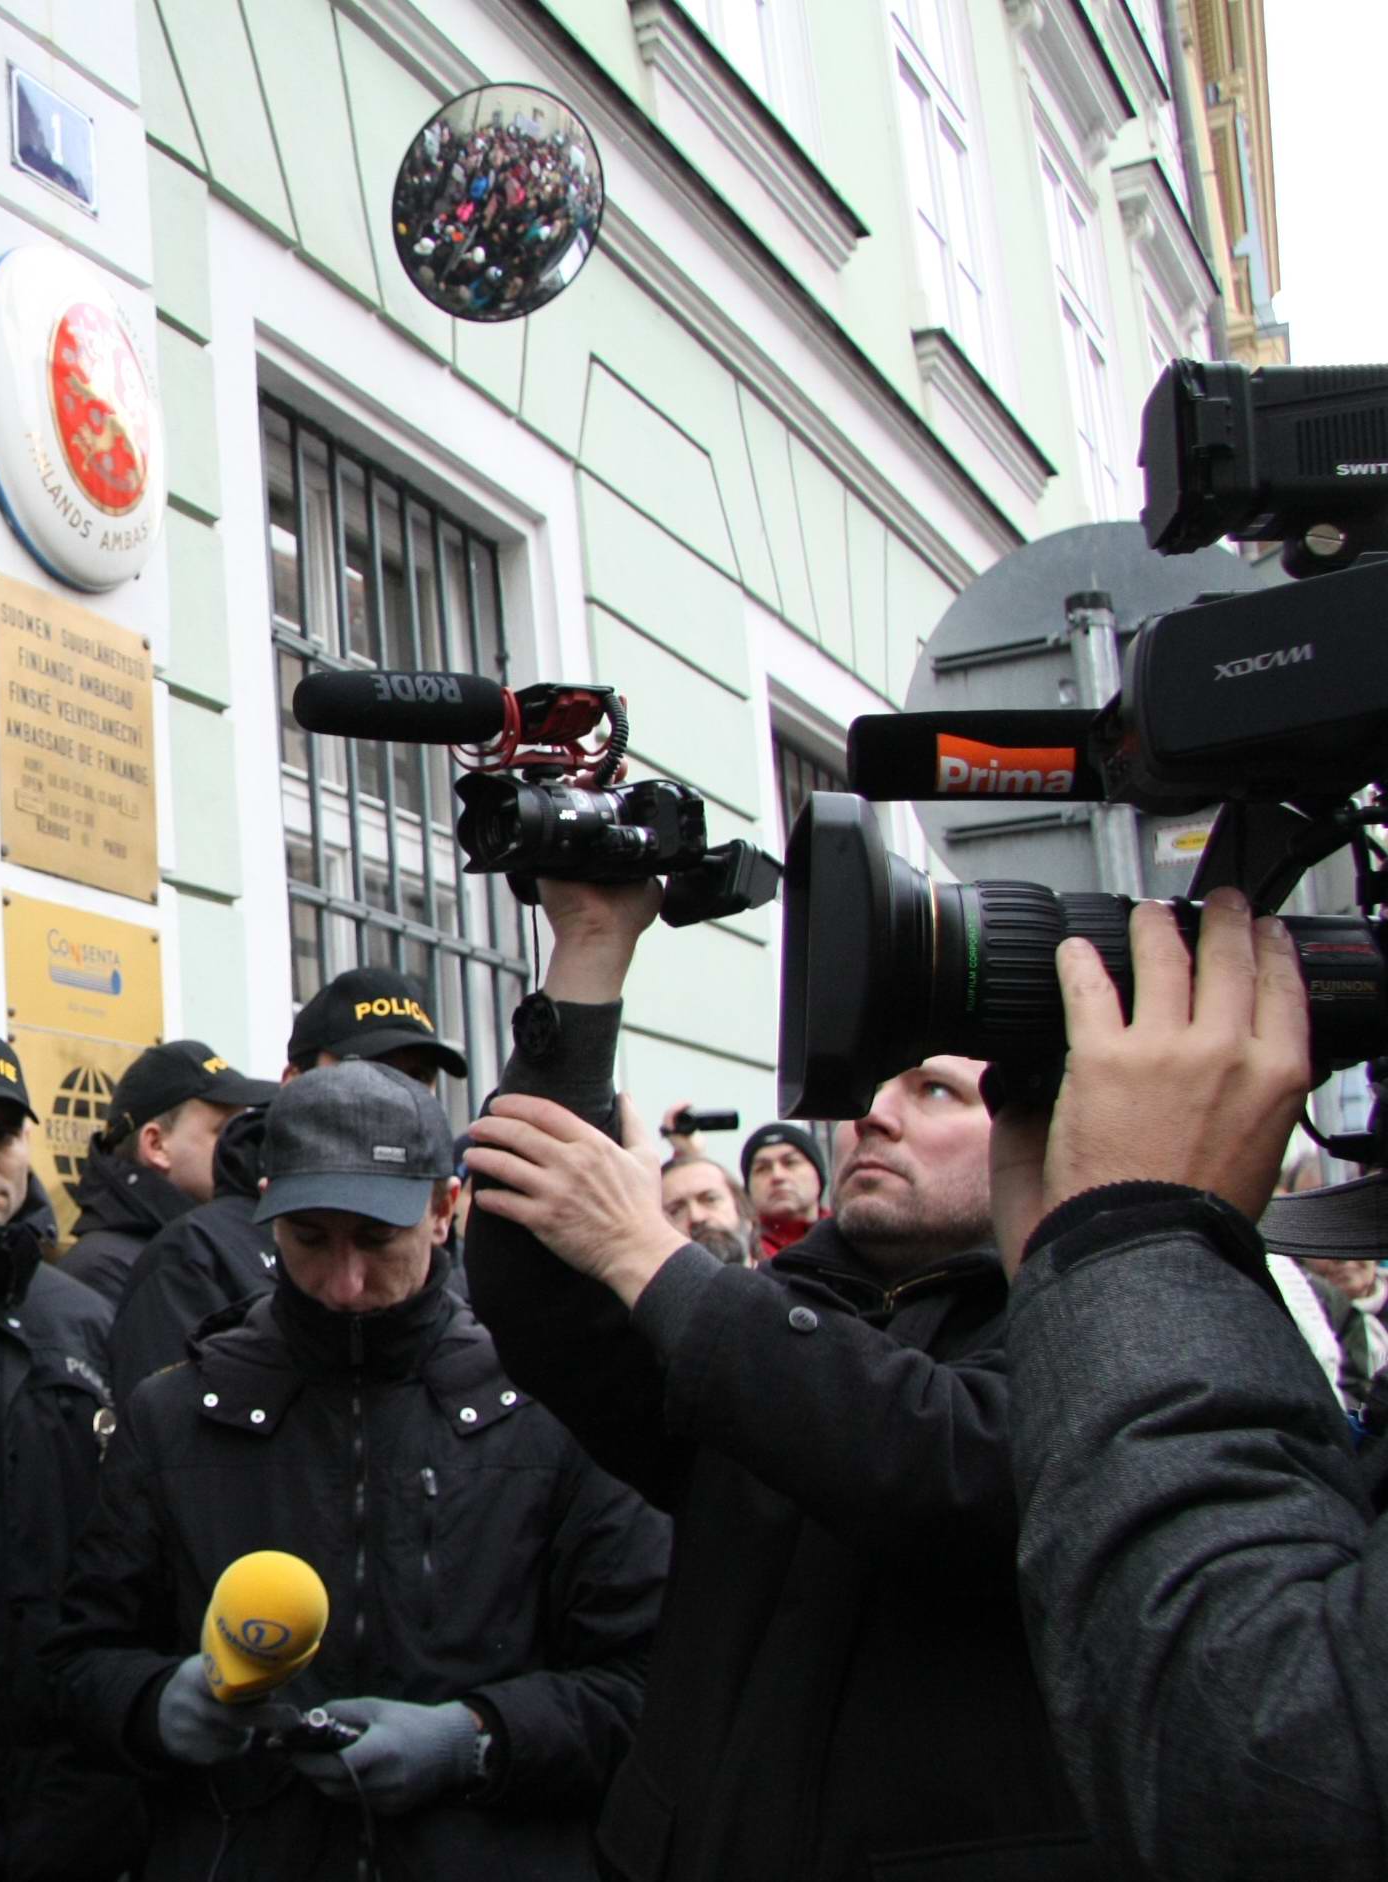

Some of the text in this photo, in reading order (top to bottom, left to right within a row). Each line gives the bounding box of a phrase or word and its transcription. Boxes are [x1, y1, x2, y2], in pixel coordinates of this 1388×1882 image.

[50, 112, 65, 167] 1
[0, 603, 52, 641] SUOMEN
[1213, 643, 1314, 681] XDCAM
[936, 755, 1075, 793] Prima
